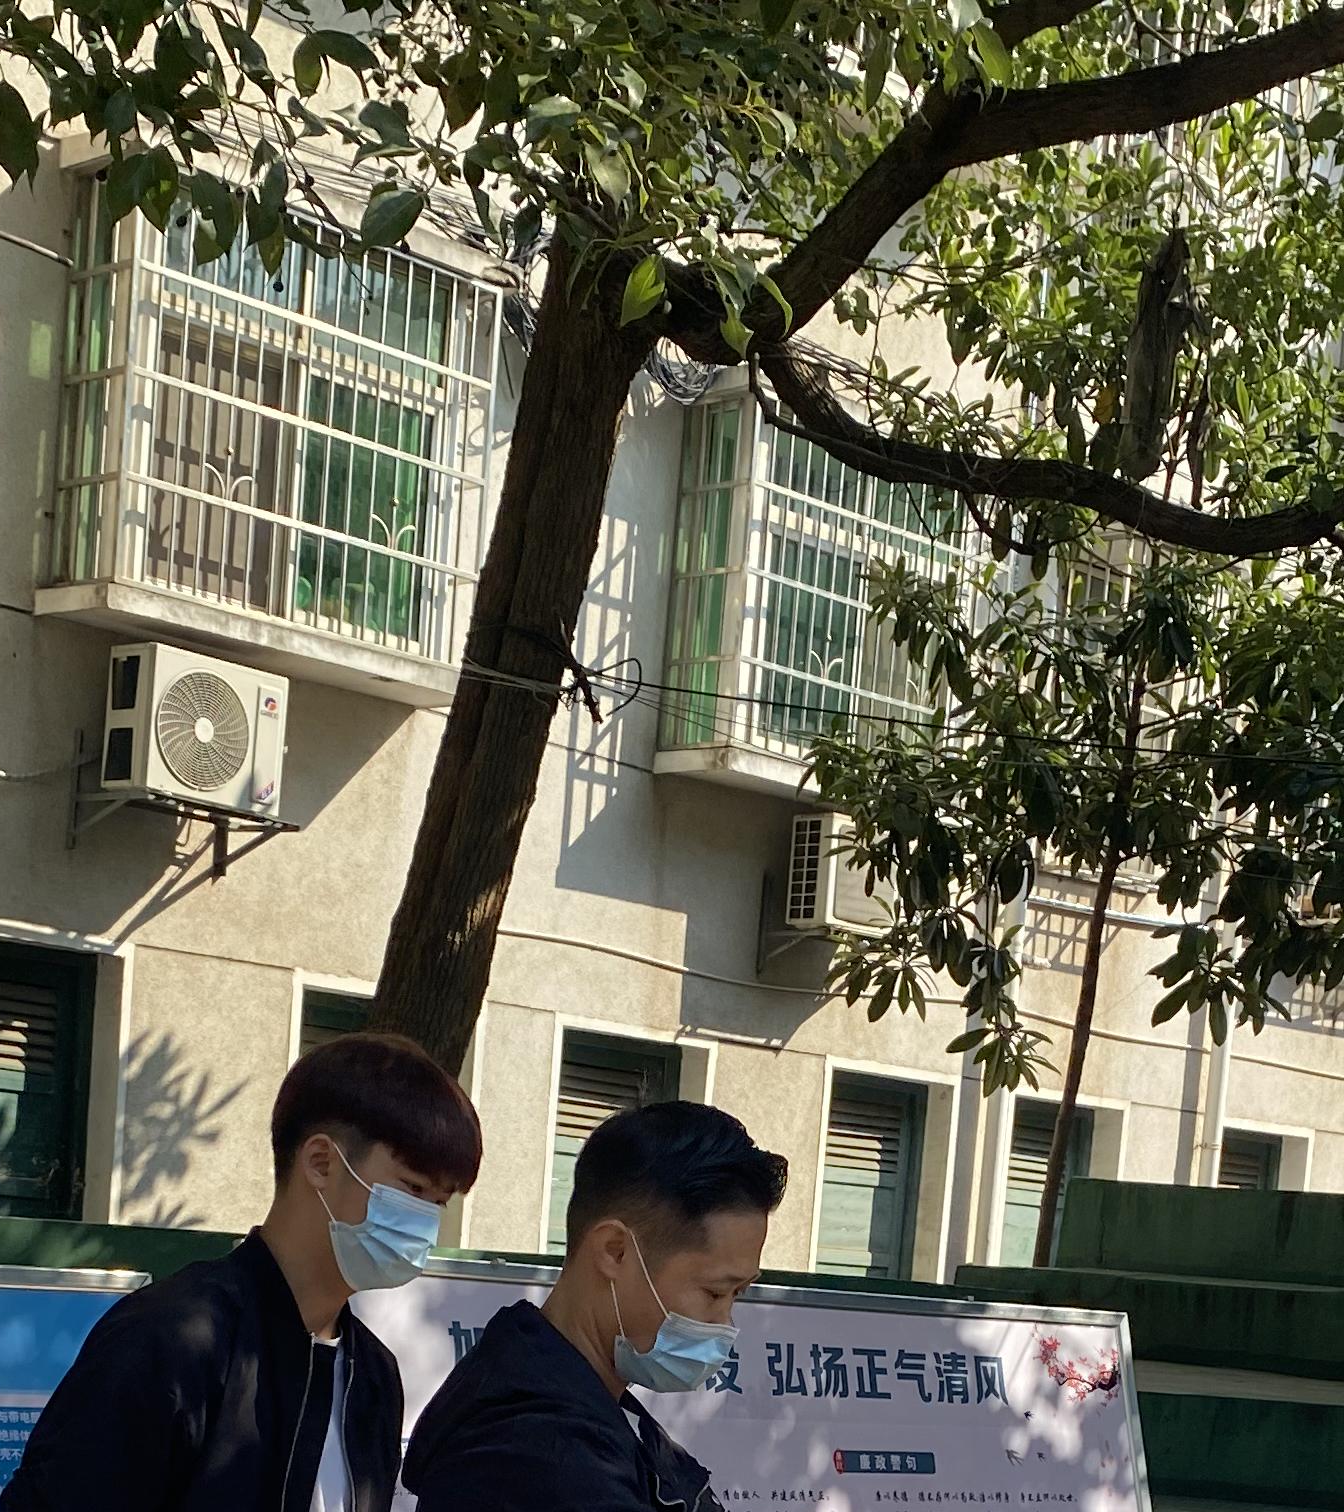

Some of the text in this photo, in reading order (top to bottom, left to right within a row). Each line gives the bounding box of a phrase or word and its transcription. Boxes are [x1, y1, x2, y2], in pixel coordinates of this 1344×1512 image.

[765, 1342, 1010, 1405] 弘扬正气清风
